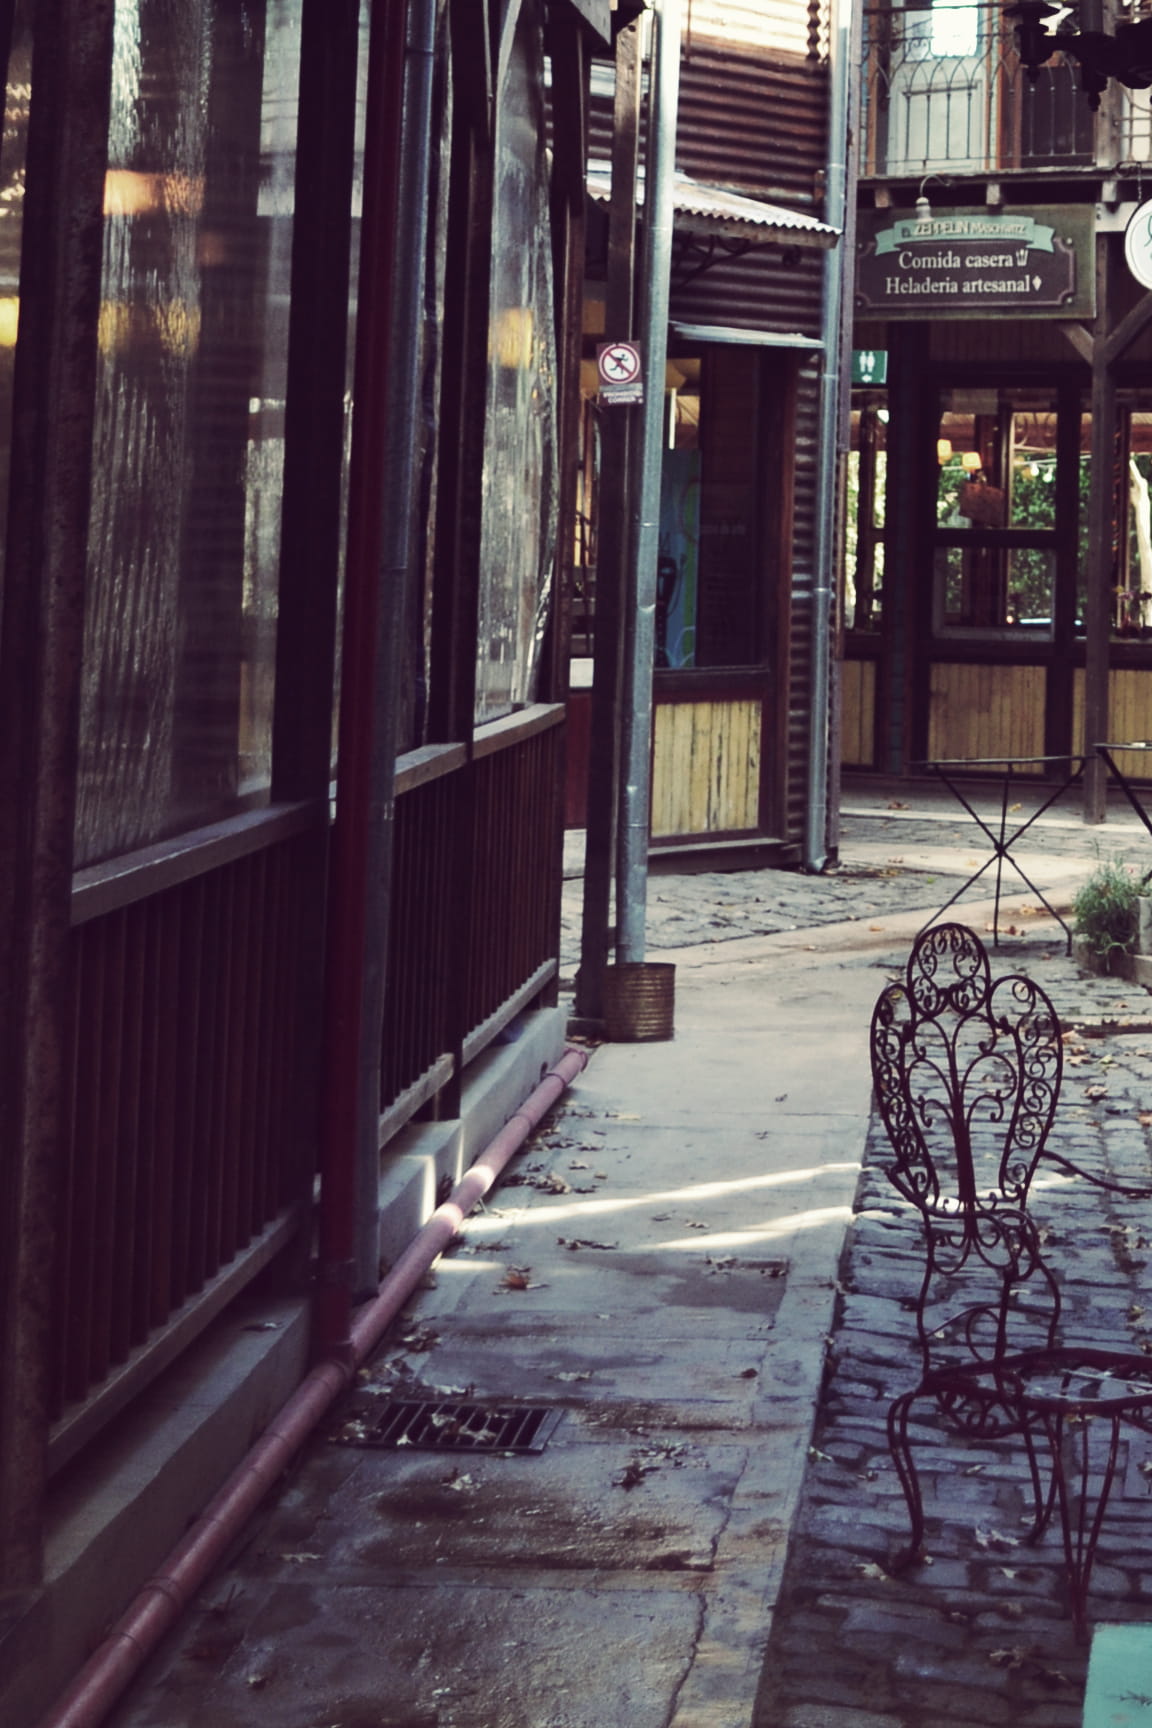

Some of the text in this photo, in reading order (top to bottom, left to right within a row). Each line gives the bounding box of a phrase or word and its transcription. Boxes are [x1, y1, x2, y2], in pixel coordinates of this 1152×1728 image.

[899, 251, 1013, 269] Comida casera
[886, 275, 1030, 294] Heladeria artesanal
